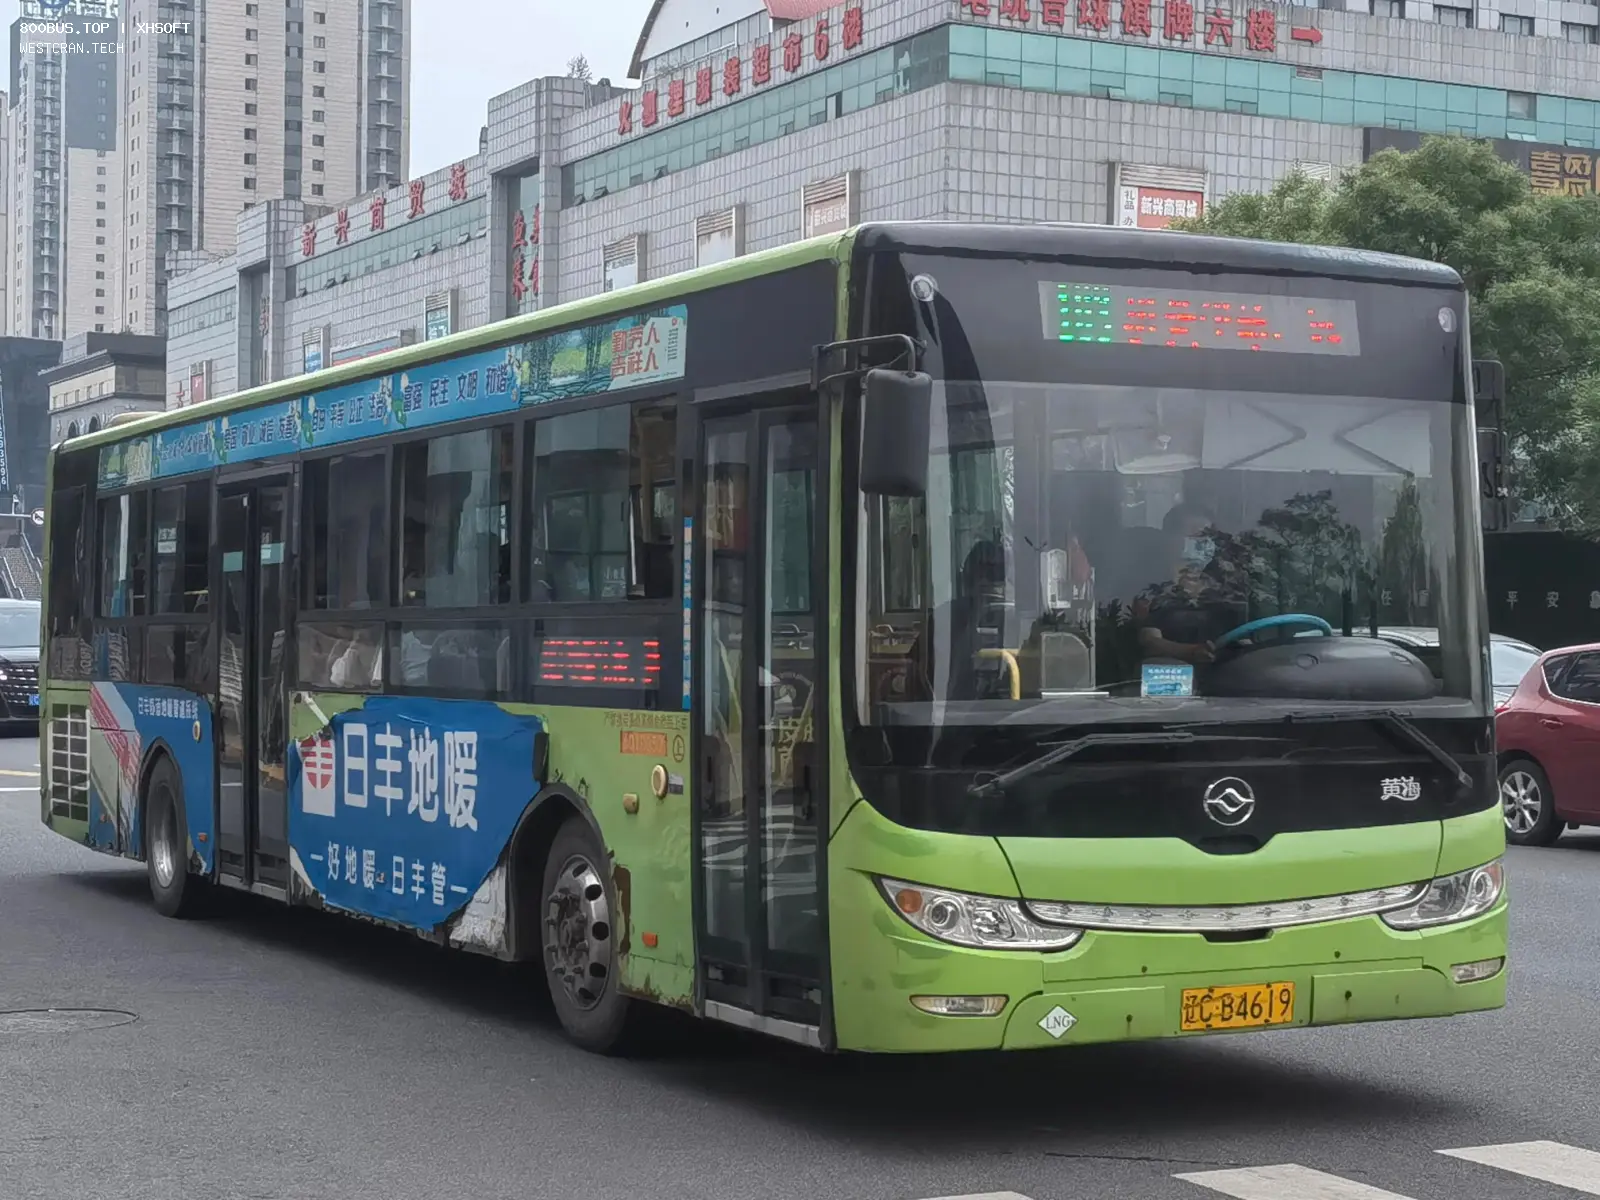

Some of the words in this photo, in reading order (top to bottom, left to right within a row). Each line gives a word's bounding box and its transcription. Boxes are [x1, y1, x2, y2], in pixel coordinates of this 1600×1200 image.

[402, 380, 424, 413] 富强
[428, 375, 450, 409] 民主
[456, 369, 479, 402] 文明
[342, 721, 479, 832] 日丰地暖
[1379, 775, 1422, 802] 黄海
[327, 839, 377, 891] 好地暖
[391, 855, 447, 907] 日丰管
[1045, 1014, 1071, 1030] LNG
